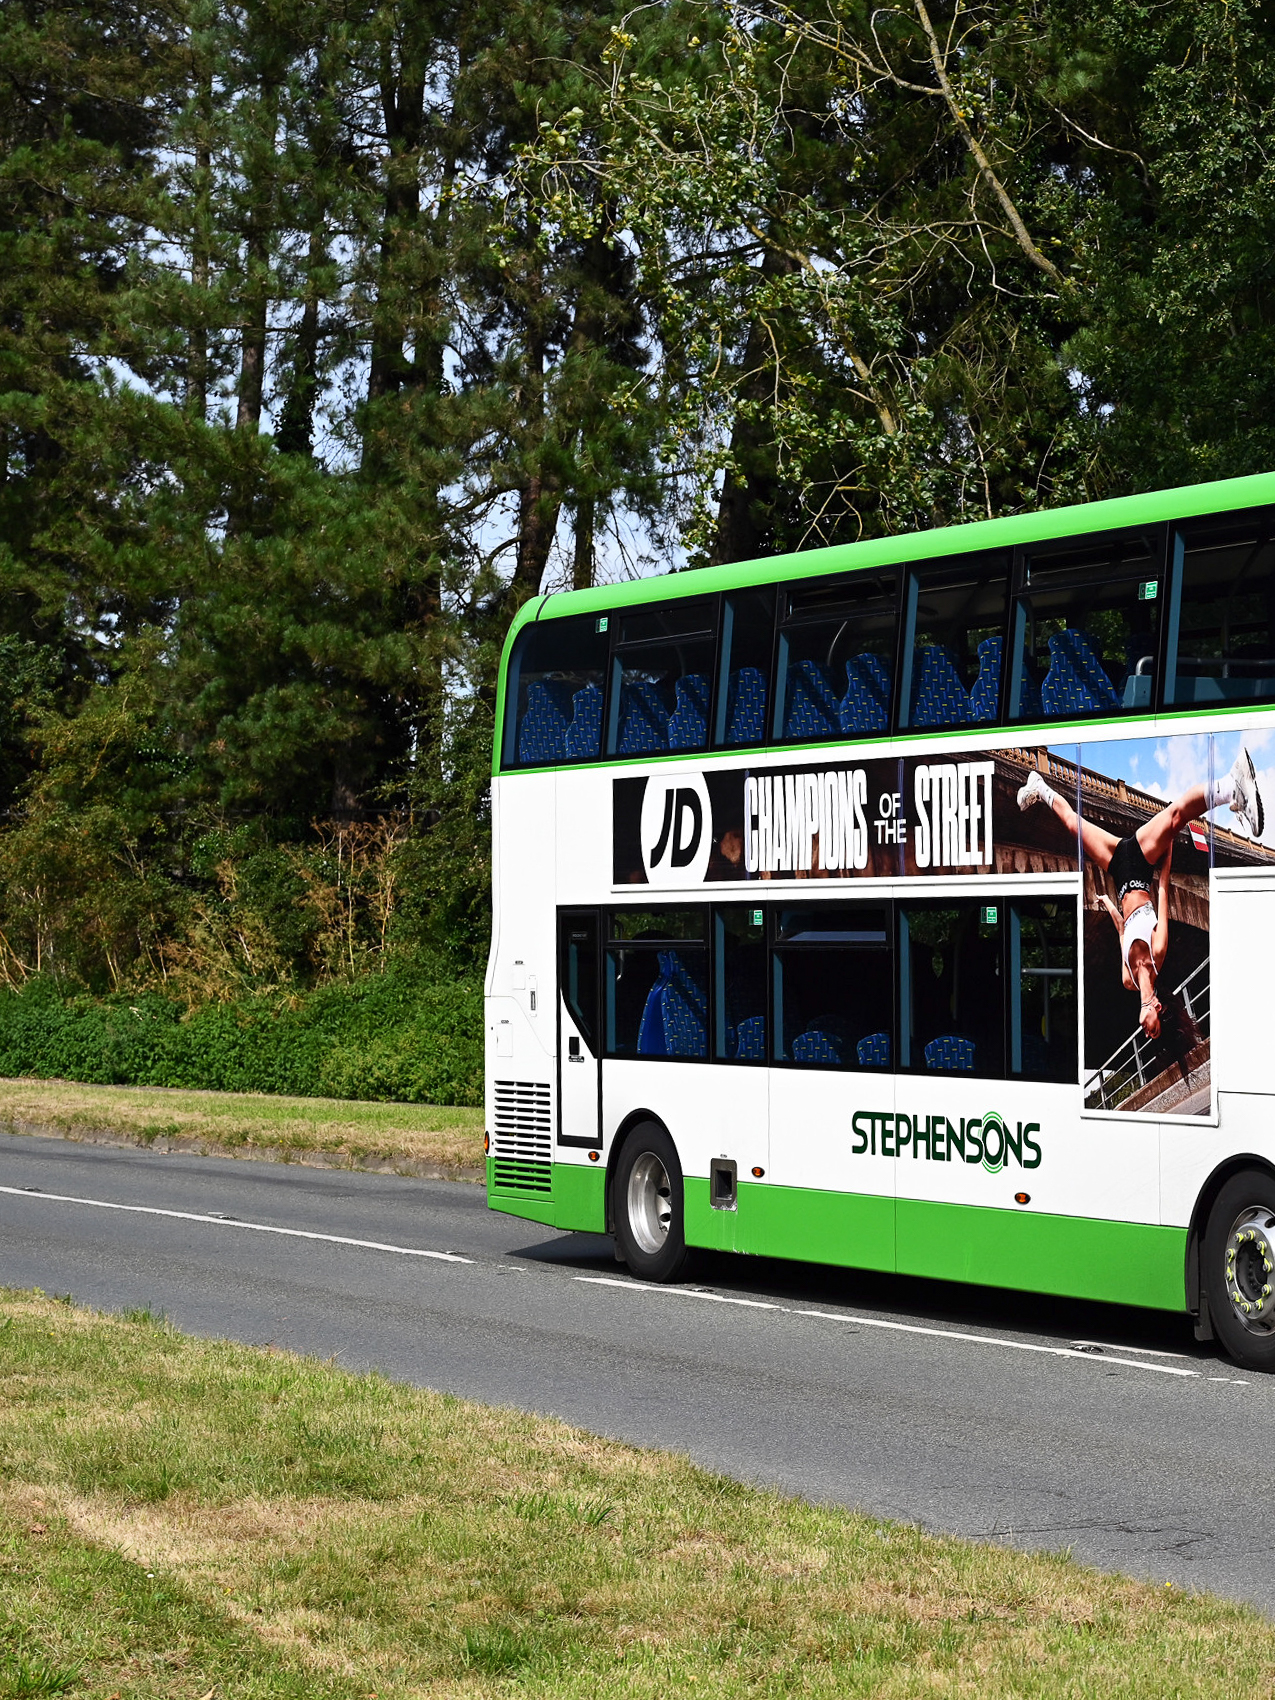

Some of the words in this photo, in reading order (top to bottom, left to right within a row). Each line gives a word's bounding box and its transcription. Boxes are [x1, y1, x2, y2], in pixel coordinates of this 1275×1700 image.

[650, 788, 702, 869] JD
[744, 769, 868, 873] CHAMPIONS
[874, 818, 907, 844] THE
[879, 793, 902, 818] OF
[914, 760, 995, 868] STREET
[852, 1111, 1042, 1170] STEPHENSONS
